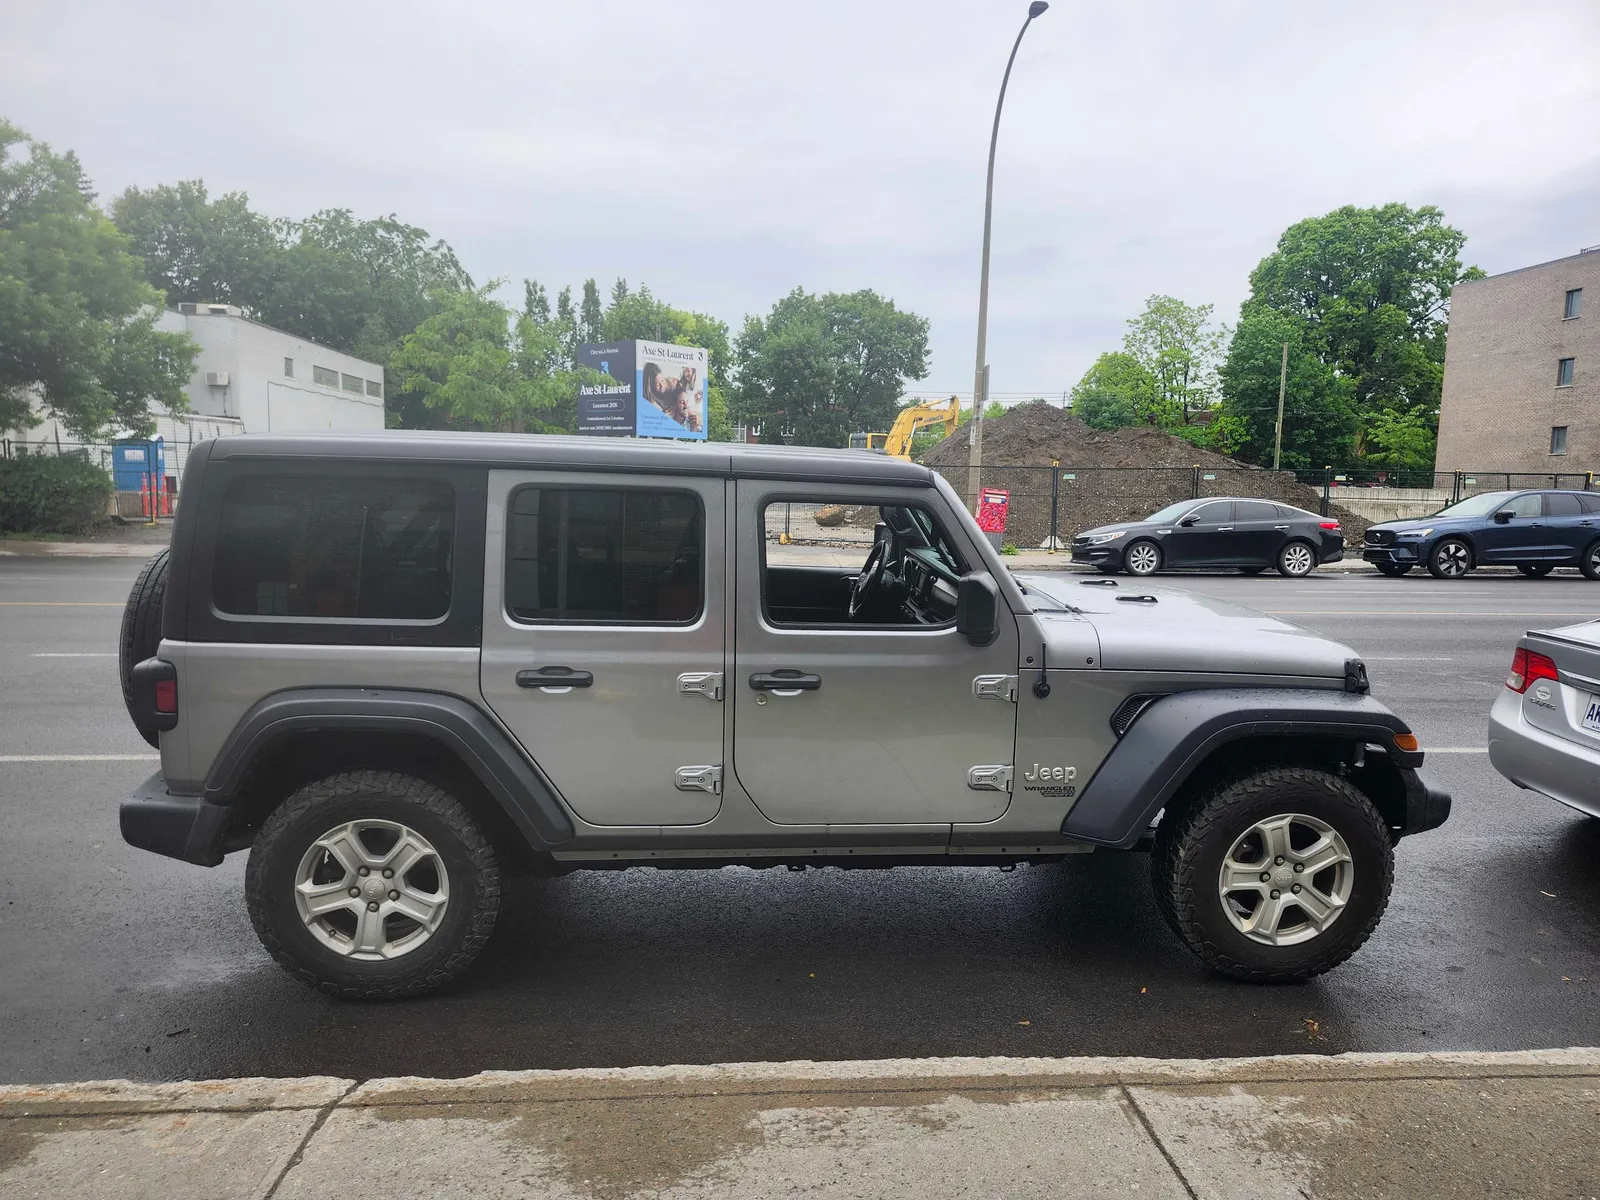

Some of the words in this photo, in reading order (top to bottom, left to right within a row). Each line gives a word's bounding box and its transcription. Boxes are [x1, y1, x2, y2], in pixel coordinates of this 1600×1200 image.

[643, 345, 656, 355] Axe
[657, 347, 694, 360] St-Laurent
[580, 384, 593, 396] Axe
[593, 383, 631, 395] St-Laurent
[1024, 763, 1077, 784] Jeep
